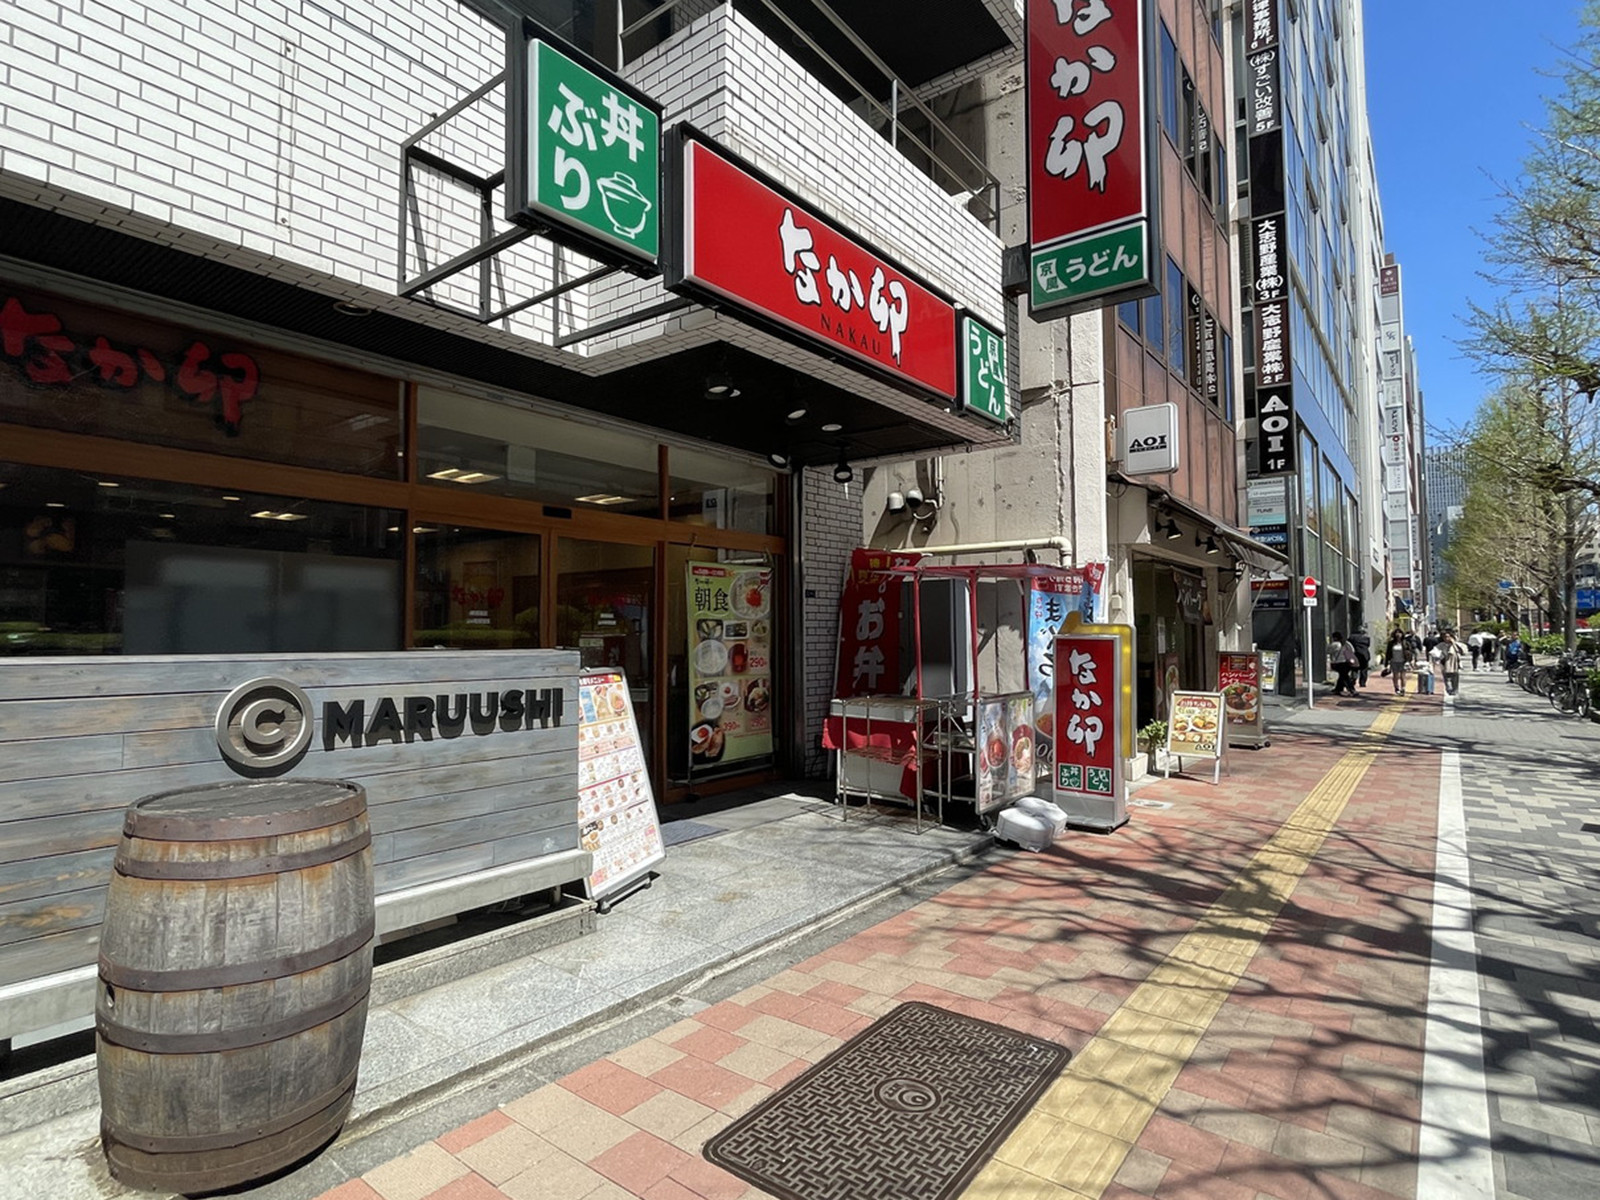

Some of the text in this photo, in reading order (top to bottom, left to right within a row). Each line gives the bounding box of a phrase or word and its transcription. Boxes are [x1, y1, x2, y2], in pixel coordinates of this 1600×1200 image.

[1066, 245, 1139, 283] うどん
[779, 207, 909, 367] なか卯
[1260, 289, 1281, 301] 3F
[820, 313, 882, 356] NAKAU
[0, 297, 259, 432] なか卯
[970, 325, 1002, 416] うどん
[1263, 373, 1285, 385] 2F
[1129, 434, 1167, 449] AOI
[1260, 395, 1289, 453] AOI
[1267, 458, 1286, 471] 1F
[694, 586, 729, 612] 朝食
[322, 687, 564, 742] MARUUSHI
[1066, 648, 1105, 758] なか卯
